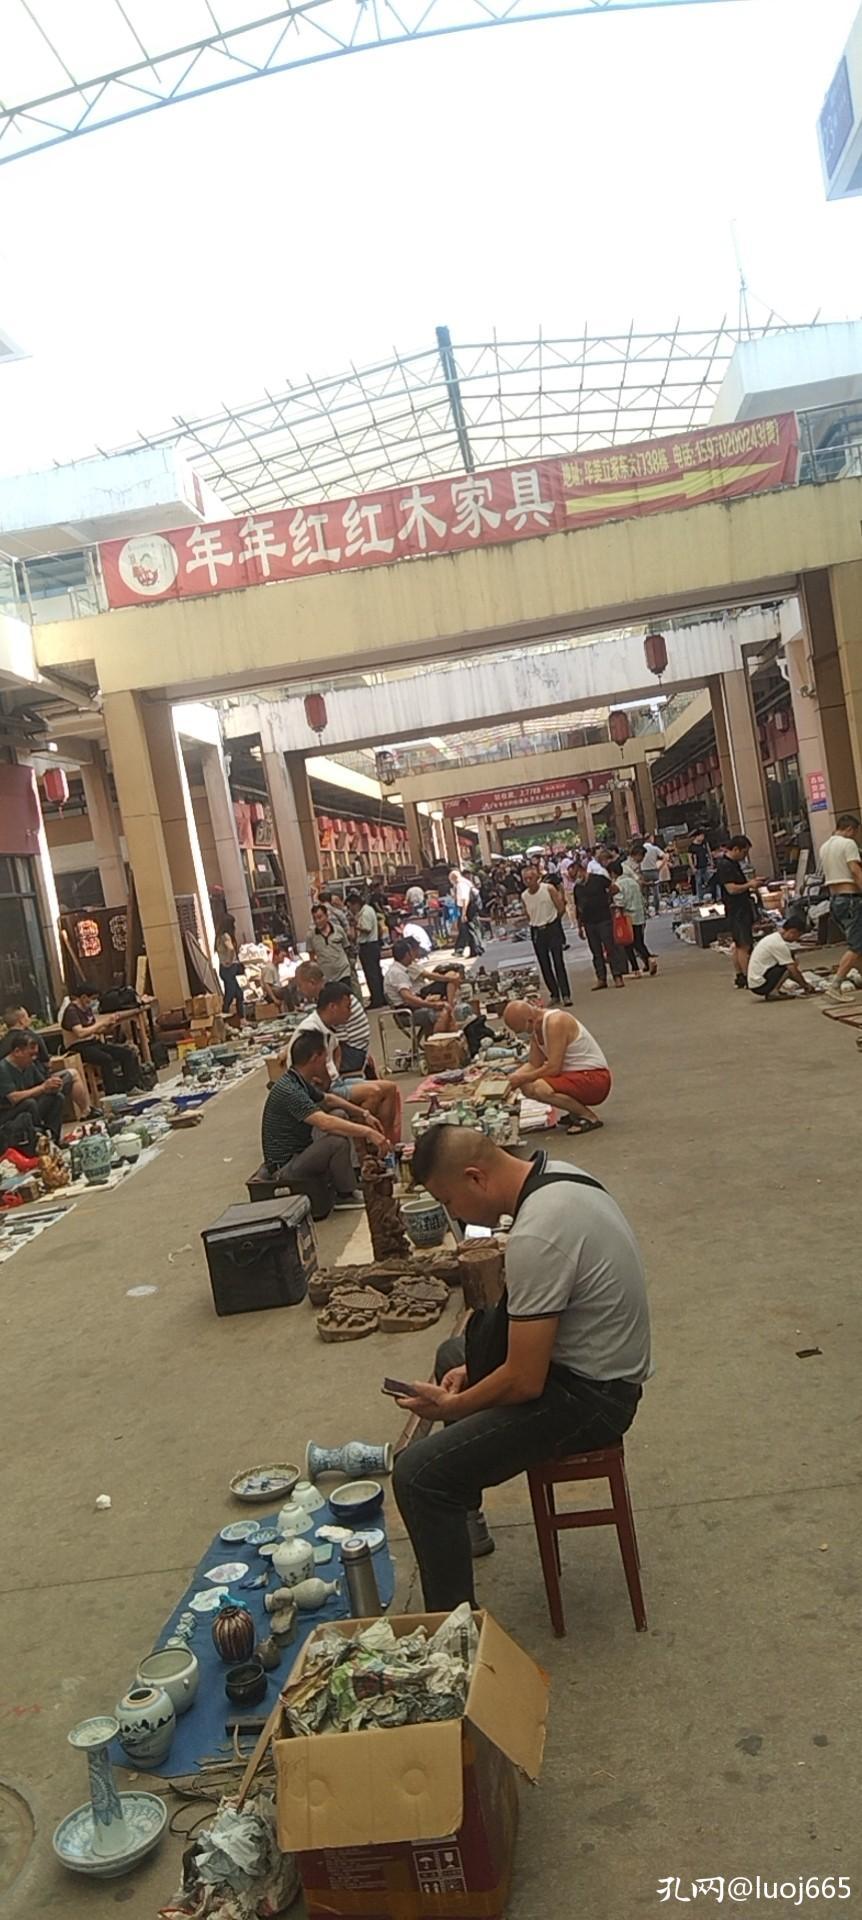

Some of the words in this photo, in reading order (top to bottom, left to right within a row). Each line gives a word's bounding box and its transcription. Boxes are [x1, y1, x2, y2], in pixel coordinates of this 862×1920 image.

[185, 468, 556, 587] 年年红红木家具
